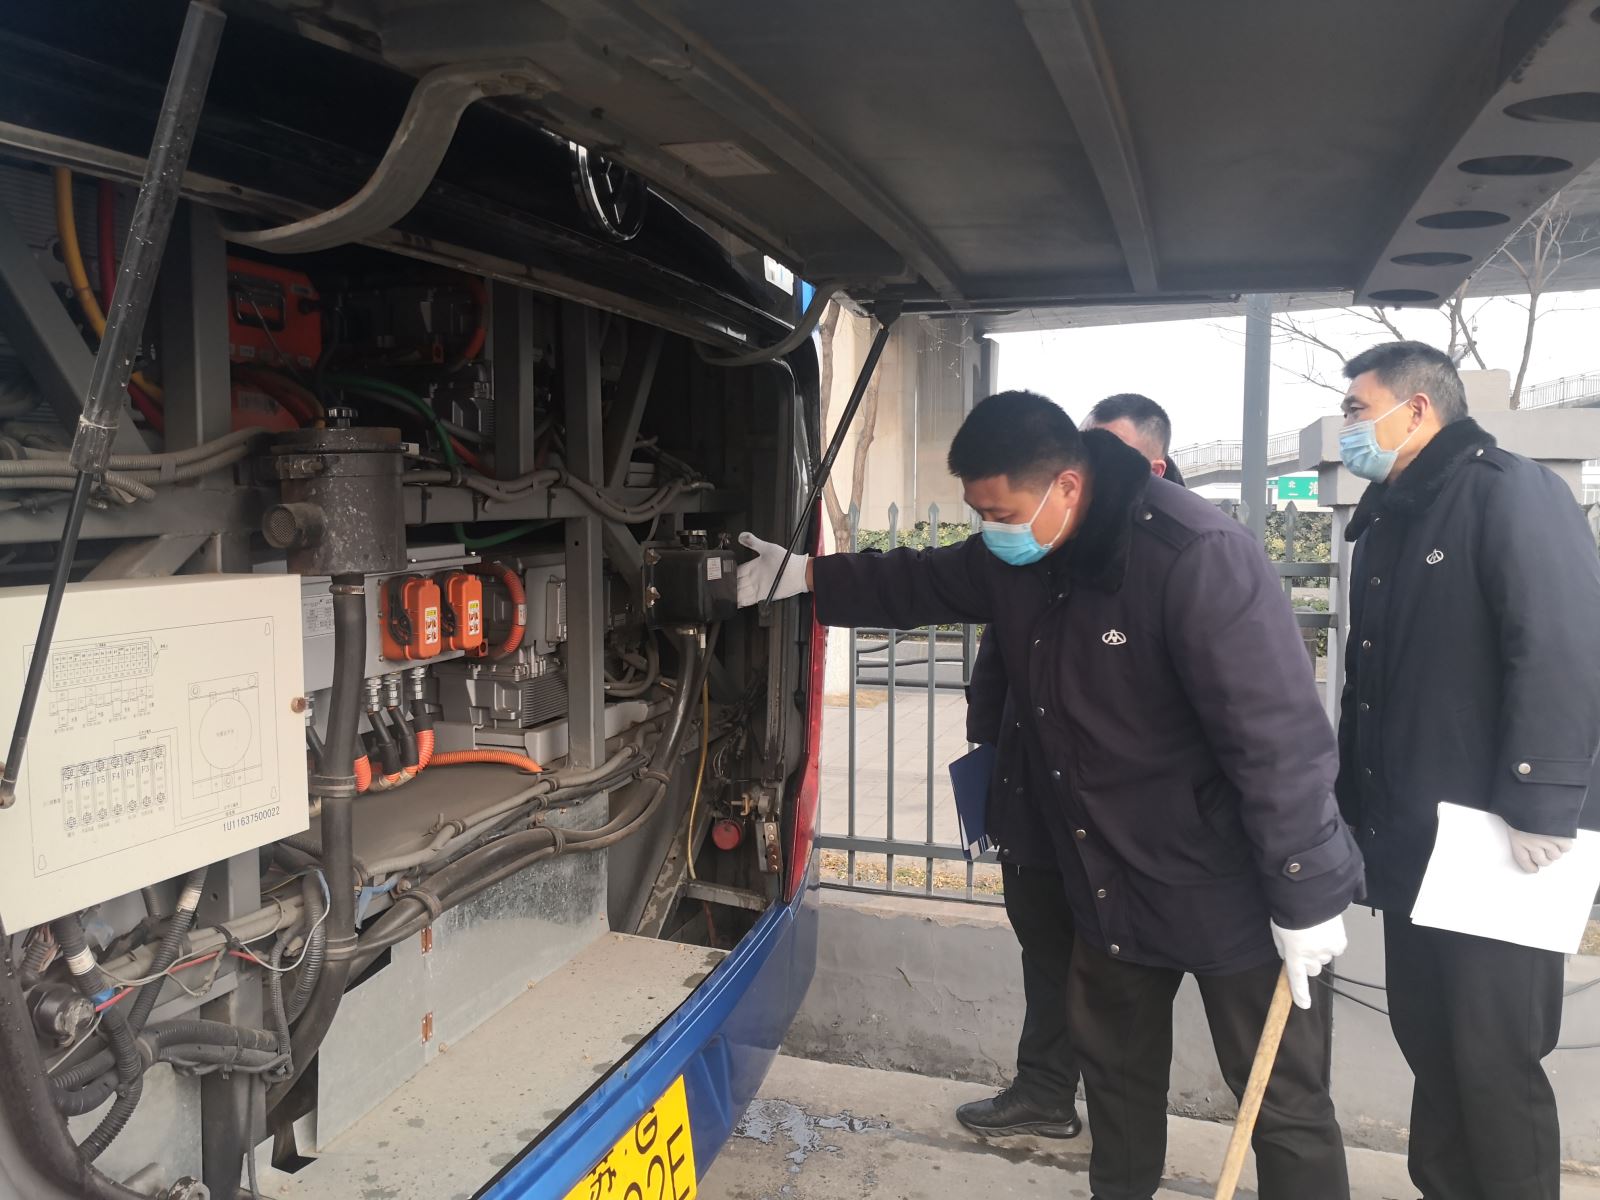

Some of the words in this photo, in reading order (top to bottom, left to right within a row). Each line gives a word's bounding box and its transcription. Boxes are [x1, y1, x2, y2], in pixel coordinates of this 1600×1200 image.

[64, 783, 74, 793] F7
[96, 775, 106, 784] F5
[112, 772, 121, 781] F4
[126, 768, 134, 777] F1
[141, 765, 150, 774] F3
[155, 761, 164, 770] F2
[223, 805, 281, 832] 1U11637500022
